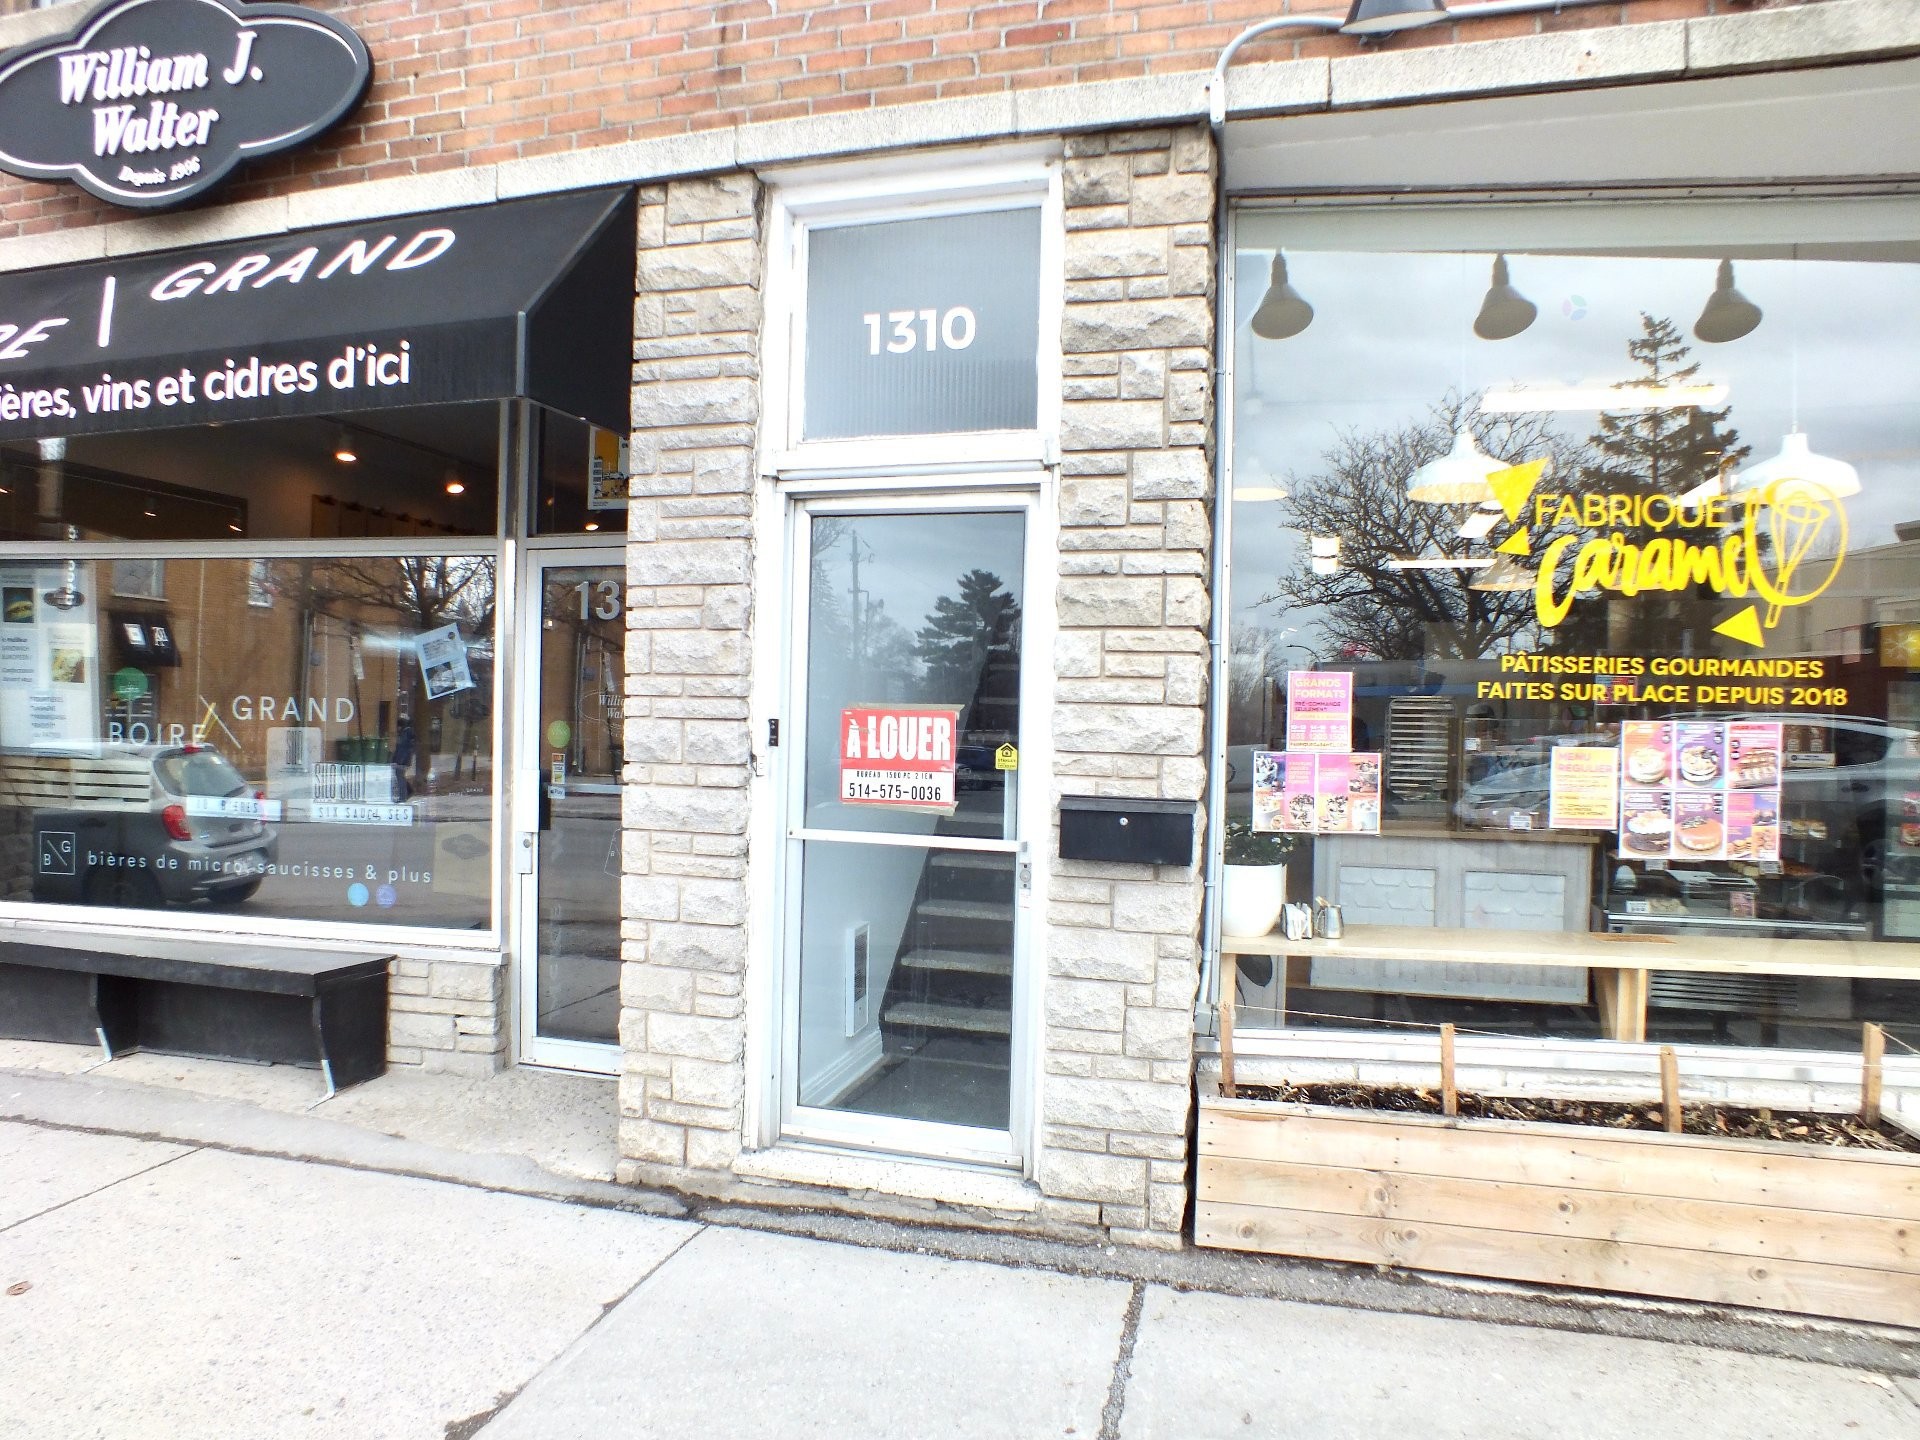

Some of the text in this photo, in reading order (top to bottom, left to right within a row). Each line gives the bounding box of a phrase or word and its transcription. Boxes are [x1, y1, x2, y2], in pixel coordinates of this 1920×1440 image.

[59, 30, 264, 104] William J.
[92, 100, 220, 157] Walter
[150, 228, 456, 301] GRAND
[863, 306, 976, 356] 1310
[82, 373, 150, 414] vins
[156, 368, 196, 407] et
[203, 355, 318, 402] cidres
[327, 340, 411, 391] d'ici
[1534, 494, 1727, 533] FABRIQUE
[1501, 650, 1824, 679] PÂTISSERIES GOURMANDES
[1295, 677, 1341, 688] GRANDS
[1295, 689, 1346, 699] FORMATS
[1476, 681, 1848, 707] FAITES SUR PLACE DEPUIS 2018
[232, 694, 356, 724] GRAND
[109, 721, 206, 746] BOIRE
[846, 715, 951, 760] À LOUER
[849, 782, 941, 801] 514-575-0036
[88, 851, 147, 868] bières
[156, 855, 178, 870] de
[257, 863, 354, 879] saucisses
[365, 866, 376, 880] &
[388, 866, 432, 884] plus
